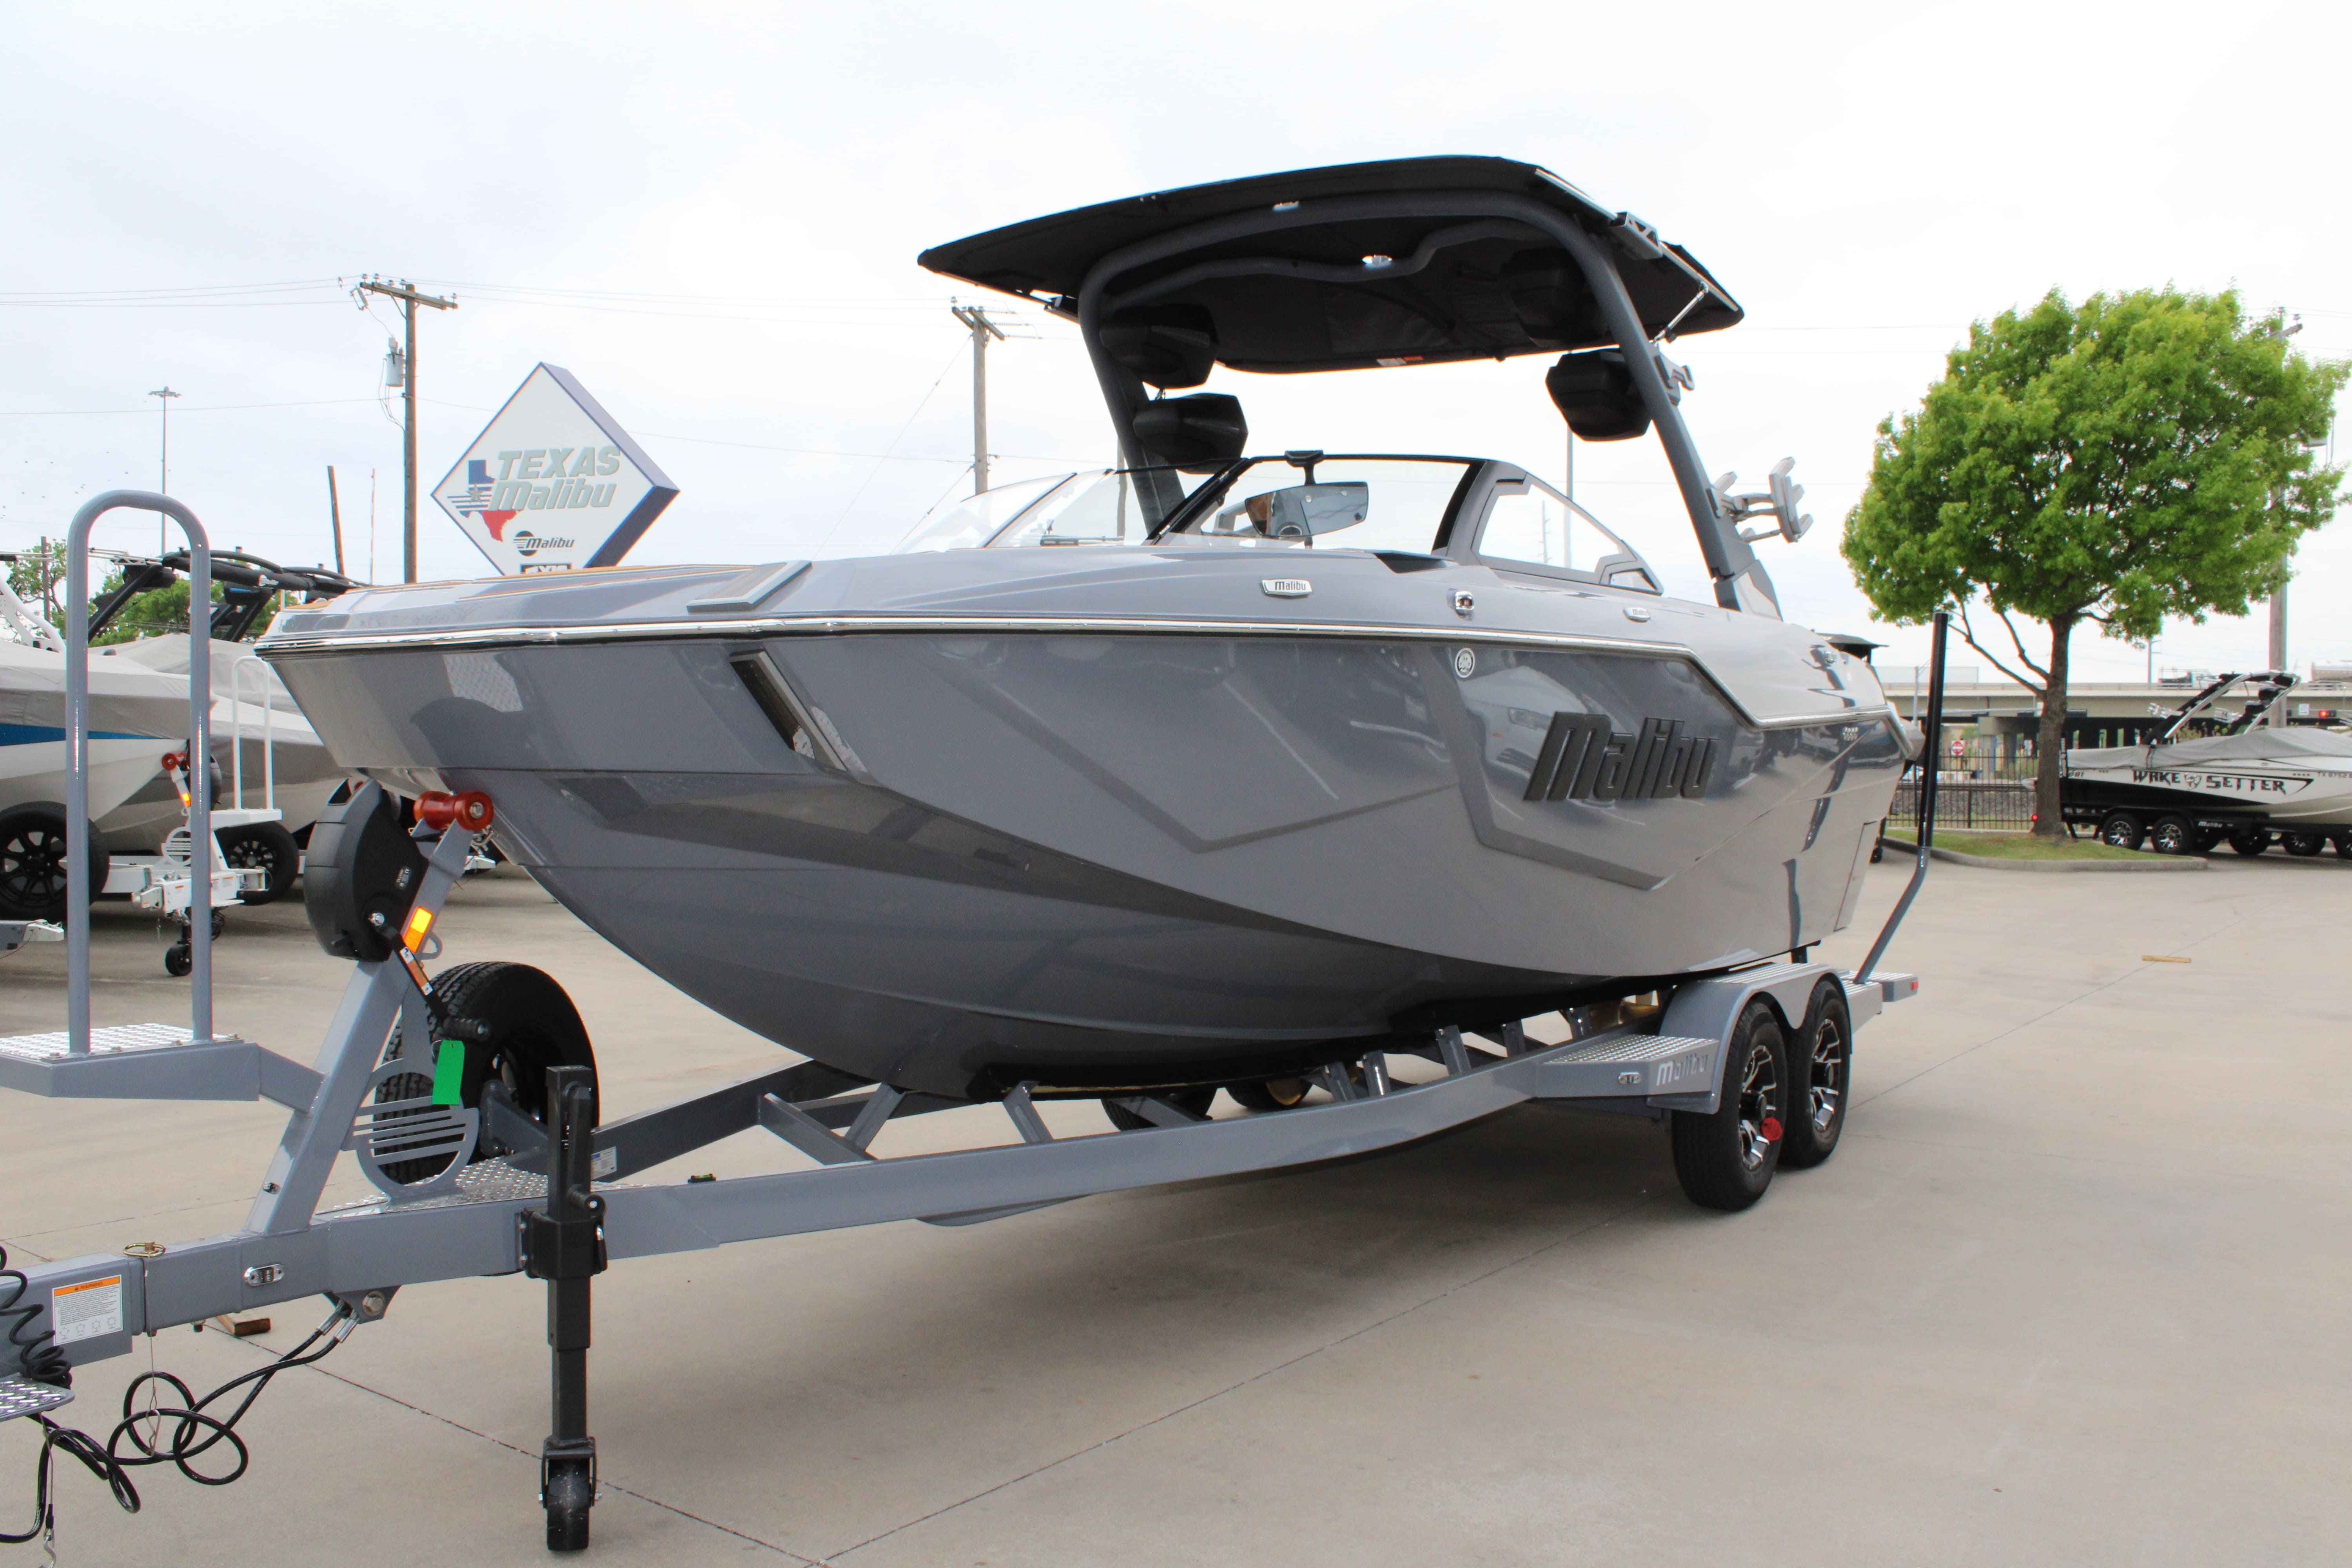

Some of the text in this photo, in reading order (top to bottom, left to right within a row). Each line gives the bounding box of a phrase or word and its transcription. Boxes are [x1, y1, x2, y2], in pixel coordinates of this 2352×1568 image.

[496, 445, 621, 481] TEXAS
[487, 478, 617, 512] Malibu
[526, 537, 575, 548] Malibu
[1275, 581, 1306, 590] Malibu
[1523, 711, 1719, 802] Malibu
[2132, 770, 2287, 795] WAKE SETTER
